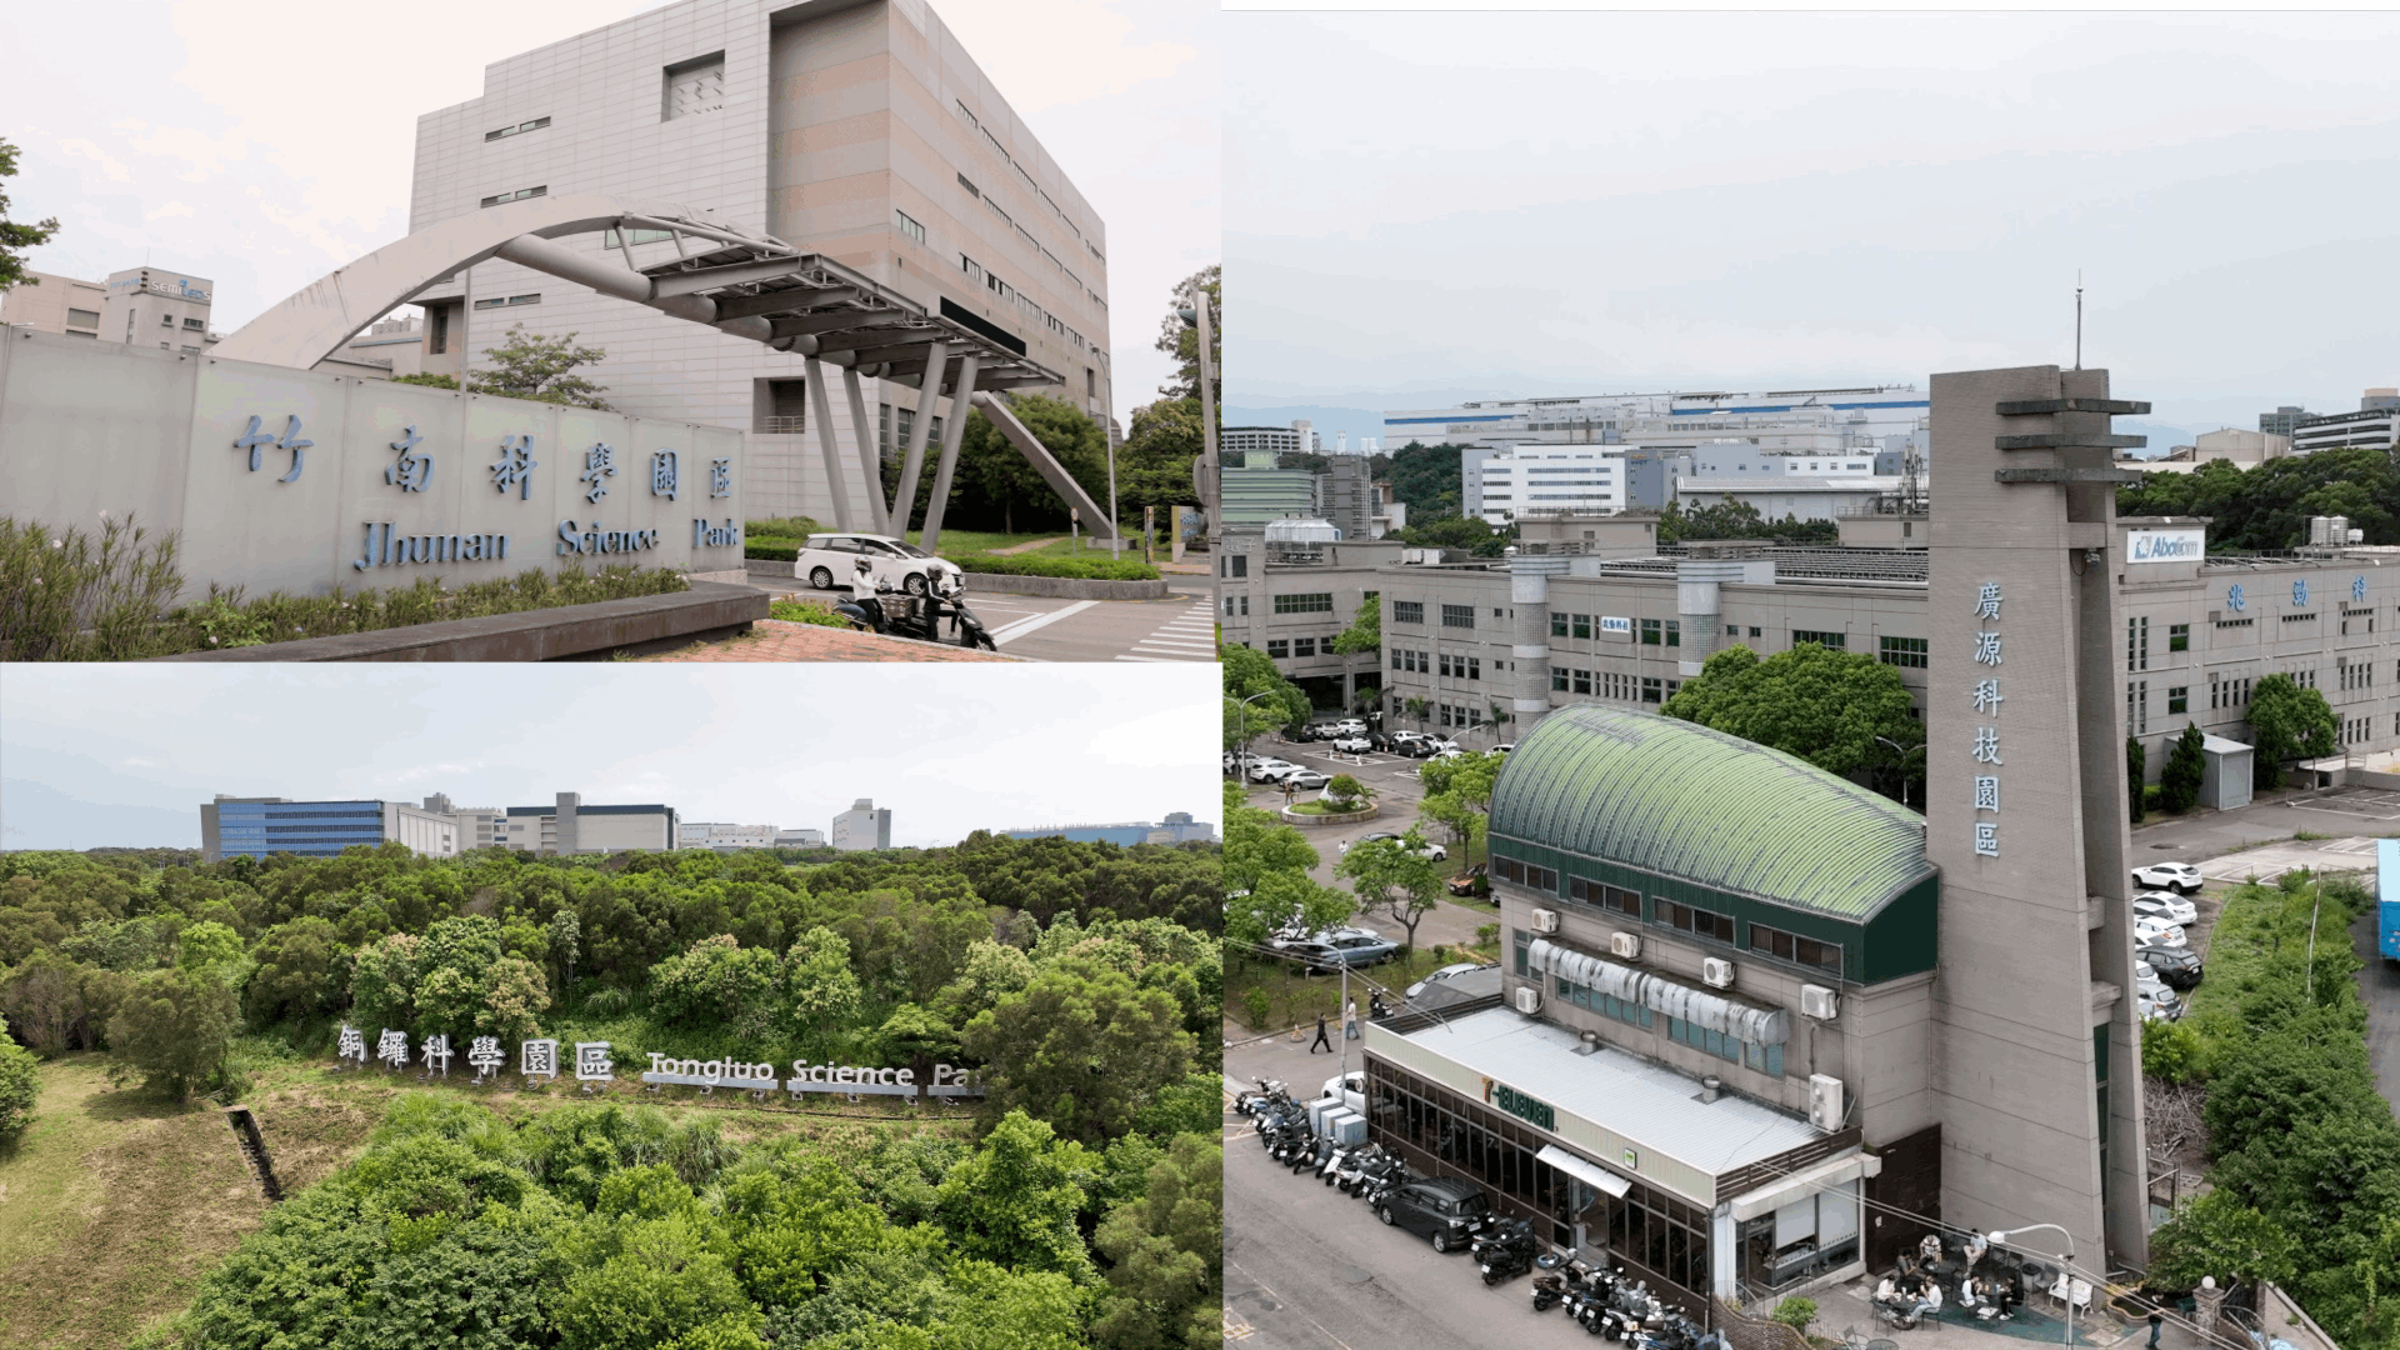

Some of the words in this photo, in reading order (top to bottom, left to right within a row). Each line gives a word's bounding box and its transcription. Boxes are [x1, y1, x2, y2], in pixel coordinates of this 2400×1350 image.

[233, 414, 732, 504] 竹南科學園區
[354, 520, 510, 571] Jhunan
[556, 519, 660, 556] Science
[692, 518, 739, 548] Park
[1972, 581, 2004, 857] 廣源科技園區
[337, 1023, 615, 1082] 銅鑼科學園區
[646, 1052, 774, 1086] Tongluo
[792, 1059, 914, 1087] Science
